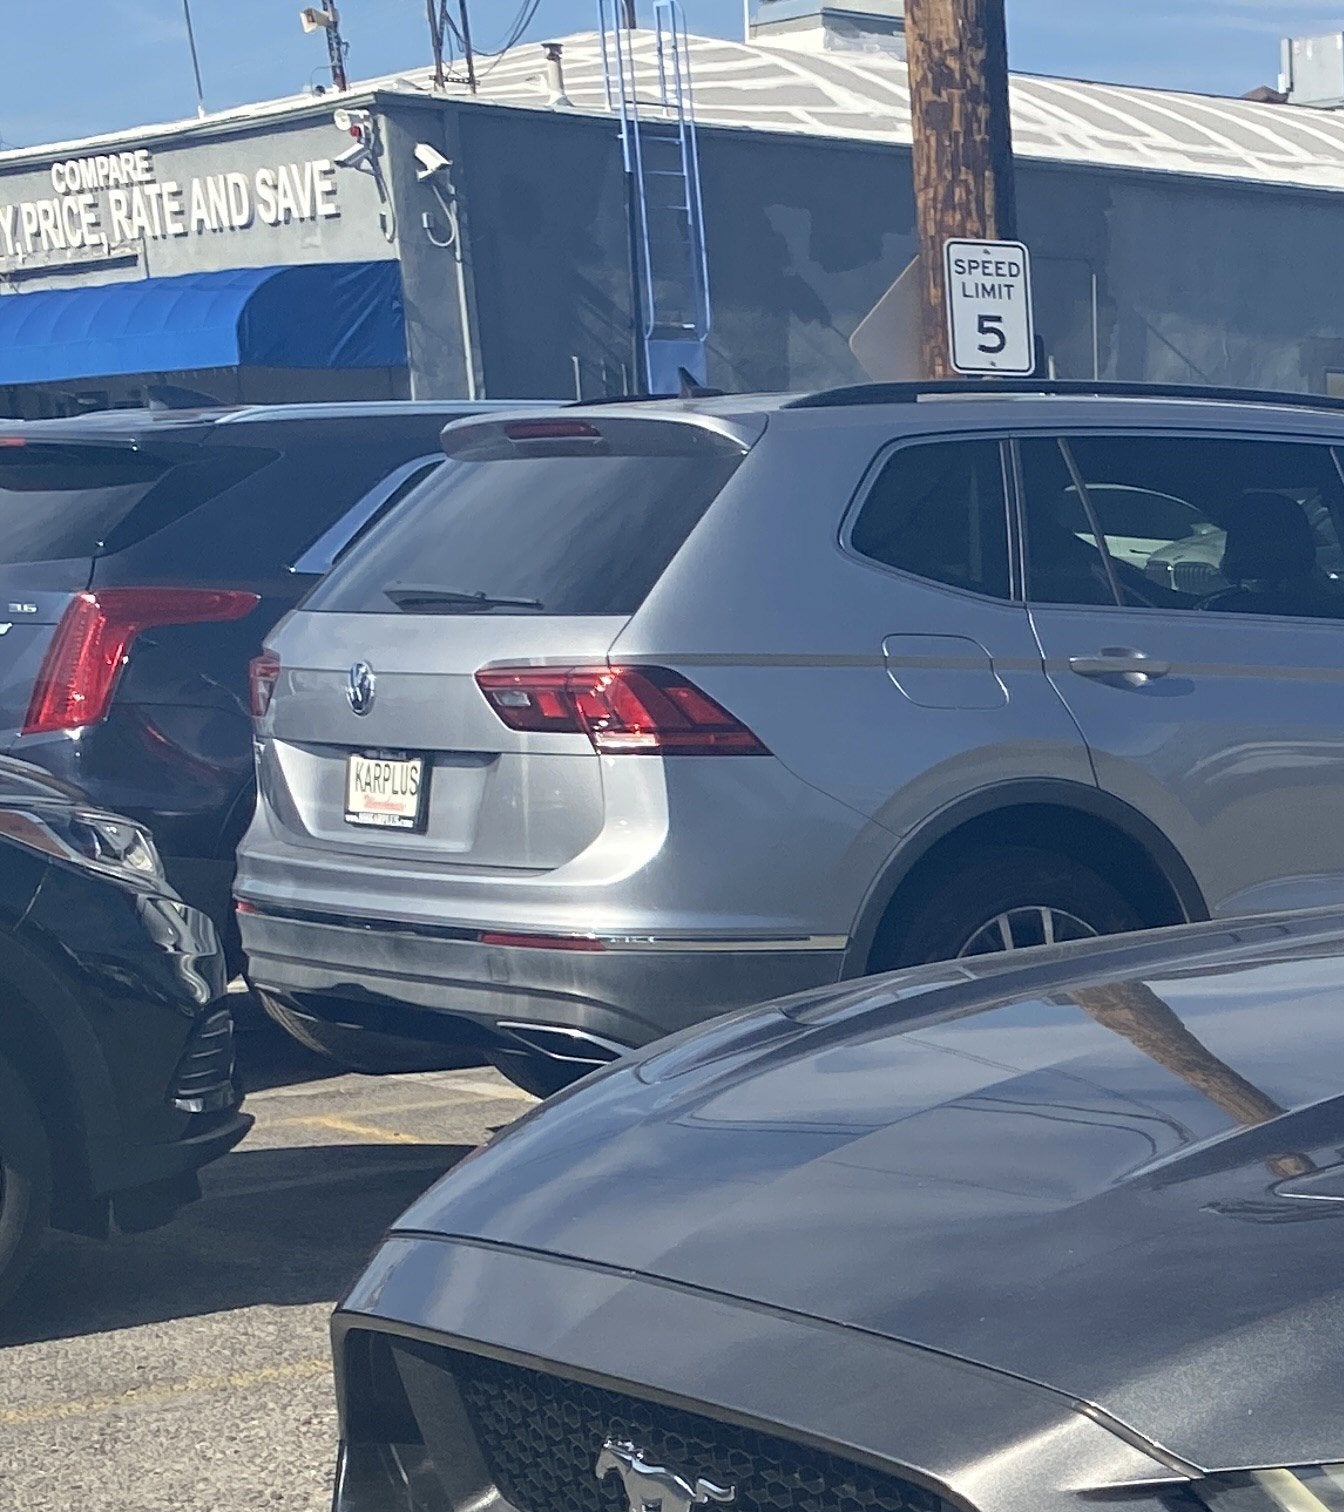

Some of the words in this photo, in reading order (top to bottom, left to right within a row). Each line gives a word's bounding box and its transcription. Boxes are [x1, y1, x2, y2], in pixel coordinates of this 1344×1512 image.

[51, 150, 152, 193] COMPARE
[109, 181, 184, 240] RATE
[191, 172, 251, 232] AND
[256, 159, 337, 224] SAVE
[954, 258, 1020, 278] SPEED
[961, 281, 1015, 300] LIMIT
[976, 313, 1006, 354] 5
[355, 761, 419, 796] KARPLUS
